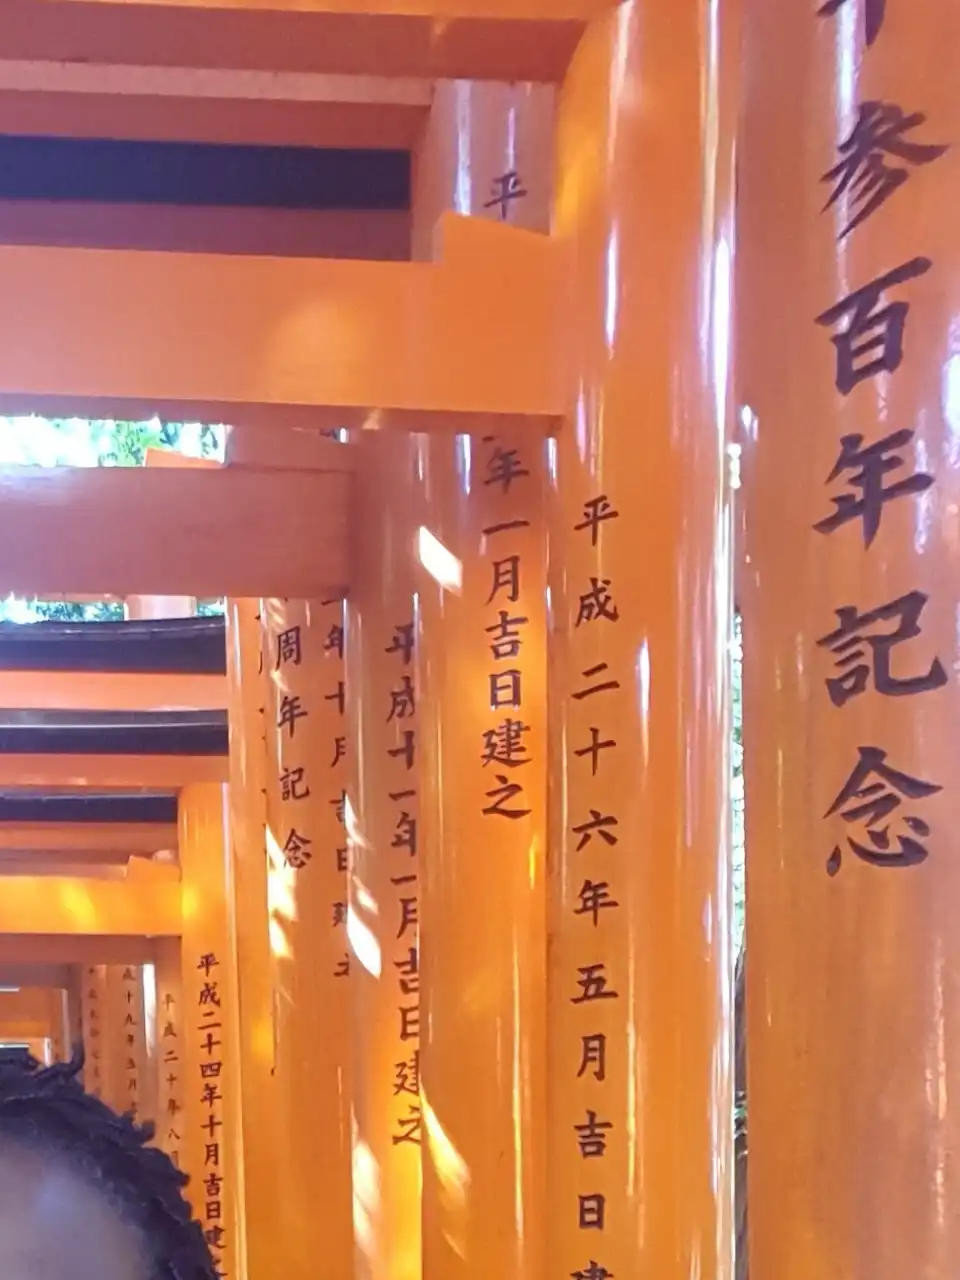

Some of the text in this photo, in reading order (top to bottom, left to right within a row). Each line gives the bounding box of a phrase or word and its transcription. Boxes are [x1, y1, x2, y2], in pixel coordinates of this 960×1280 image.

[484, 171, 528, 220] 平
[276, 626, 312, 870] 周年記念
